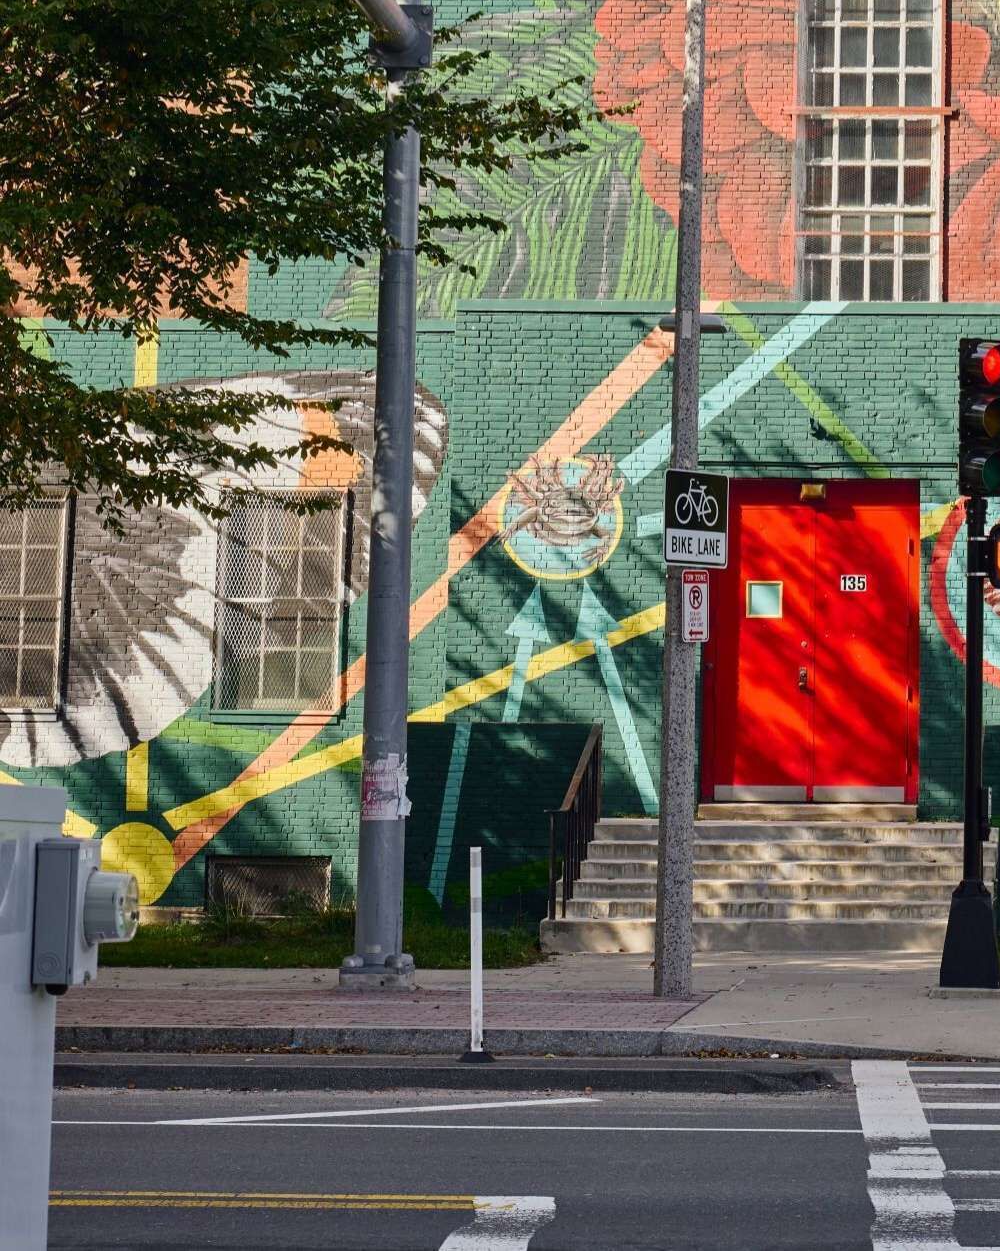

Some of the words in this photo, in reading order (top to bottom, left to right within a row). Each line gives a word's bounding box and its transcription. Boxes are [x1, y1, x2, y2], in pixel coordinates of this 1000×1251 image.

[671, 535, 693, 555] BIKE
[697, 537, 721, 556] LANE
[842, 576, 866, 590] 135
